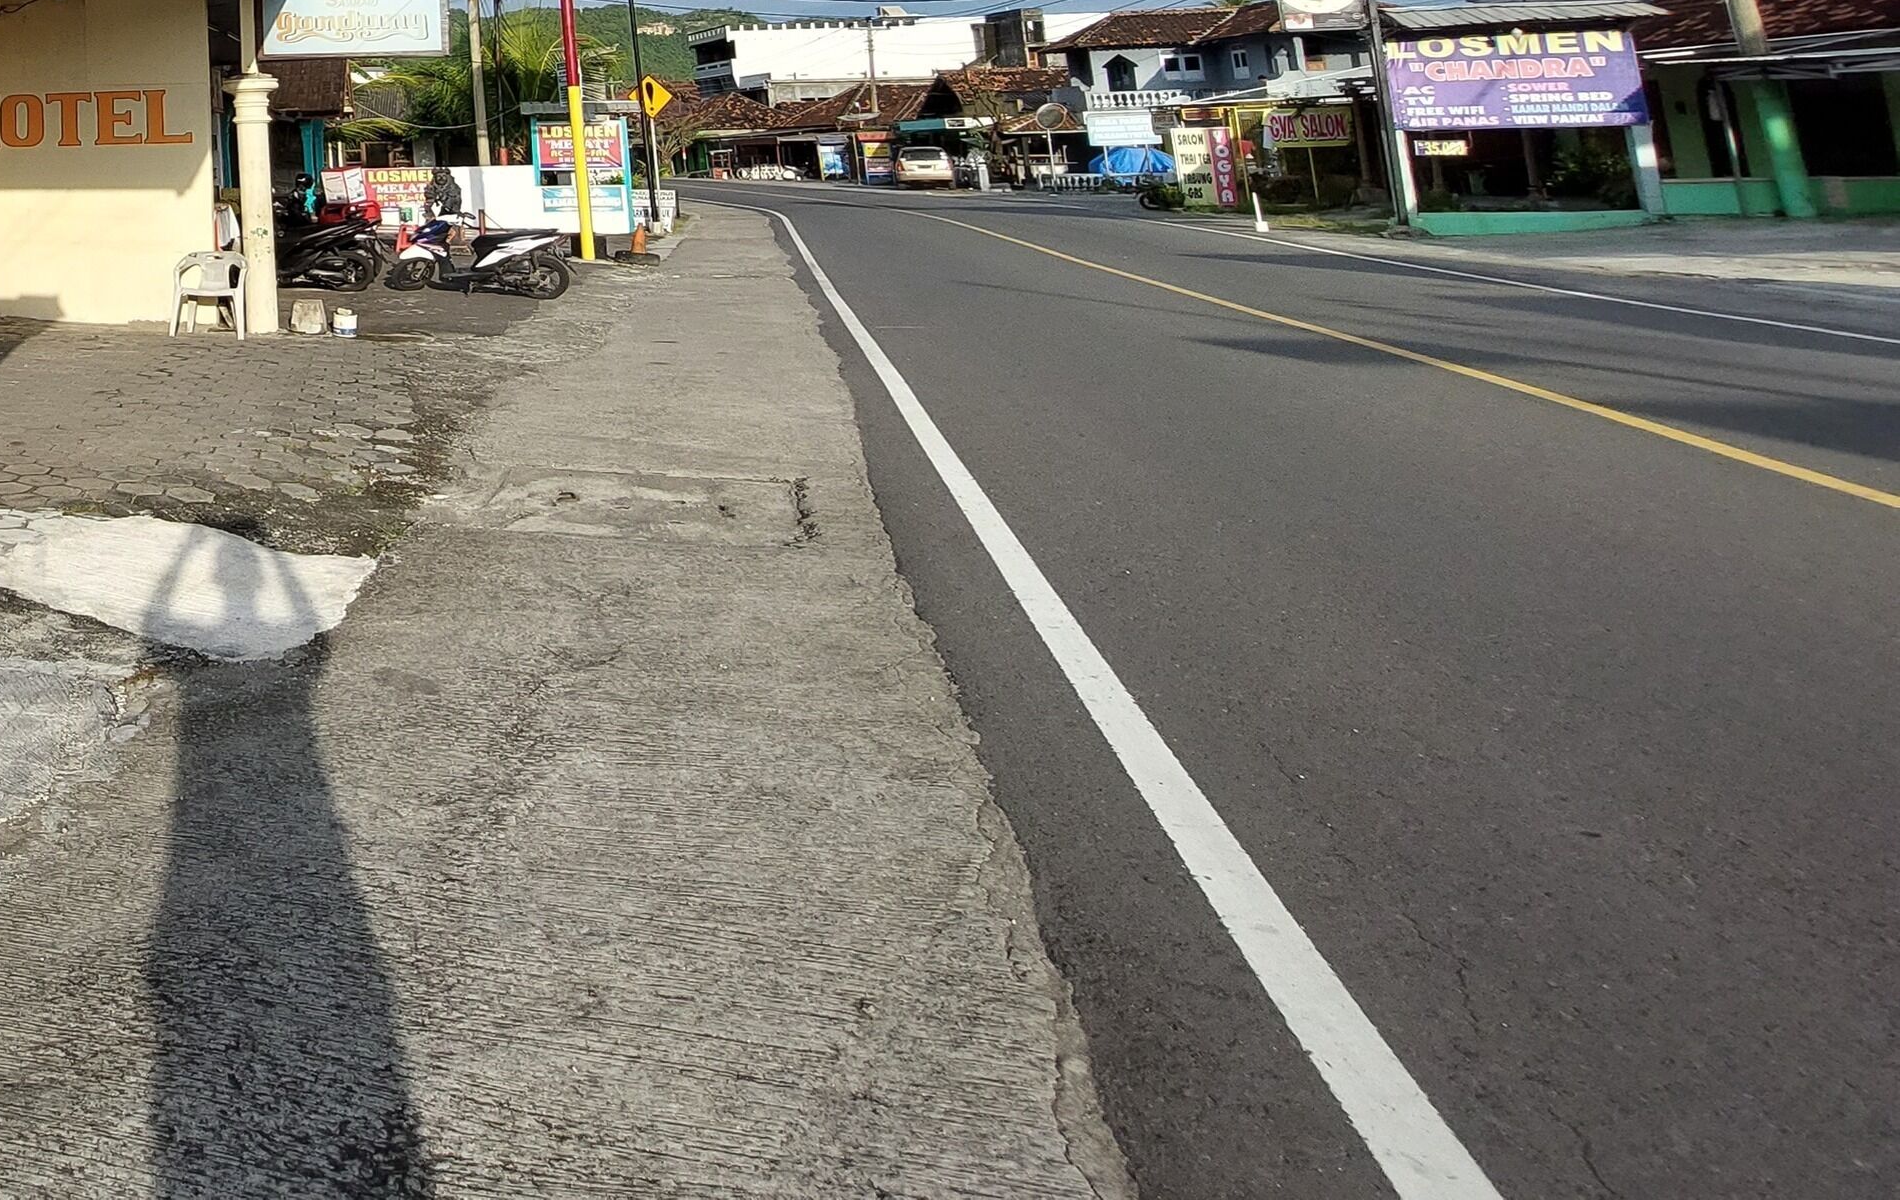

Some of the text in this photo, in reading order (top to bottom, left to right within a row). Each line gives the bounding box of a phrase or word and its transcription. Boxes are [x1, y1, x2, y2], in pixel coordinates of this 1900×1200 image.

[1386, 31, 1625, 60] LOSMEN
[1409, 56, 1606, 81] "CHANDRA"
[1402, 85, 1435, 95] AC
[1507, 82, 1570, 92] SOWER
[1404, 96, 1435, 105] TV
[1508, 91, 1614, 103] SPRING BED
[1406, 106, 1485, 116] FREE WIFI
[1511, 104, 1550, 113] KAMAR
[1552, 103, 1589, 112] MANDI
[1409, 116, 1500, 127] AIR PANAS
[1513, 114, 1605, 125] VIEW PANTAI
[1301, 113, 1347, 138] SALON
[1178, 133, 1204, 145] SALON
[1180, 153, 1196, 164] THAI
[1212, 130, 1234, 202] YOGYA
[372, 183, 427, 193] "MELAT
